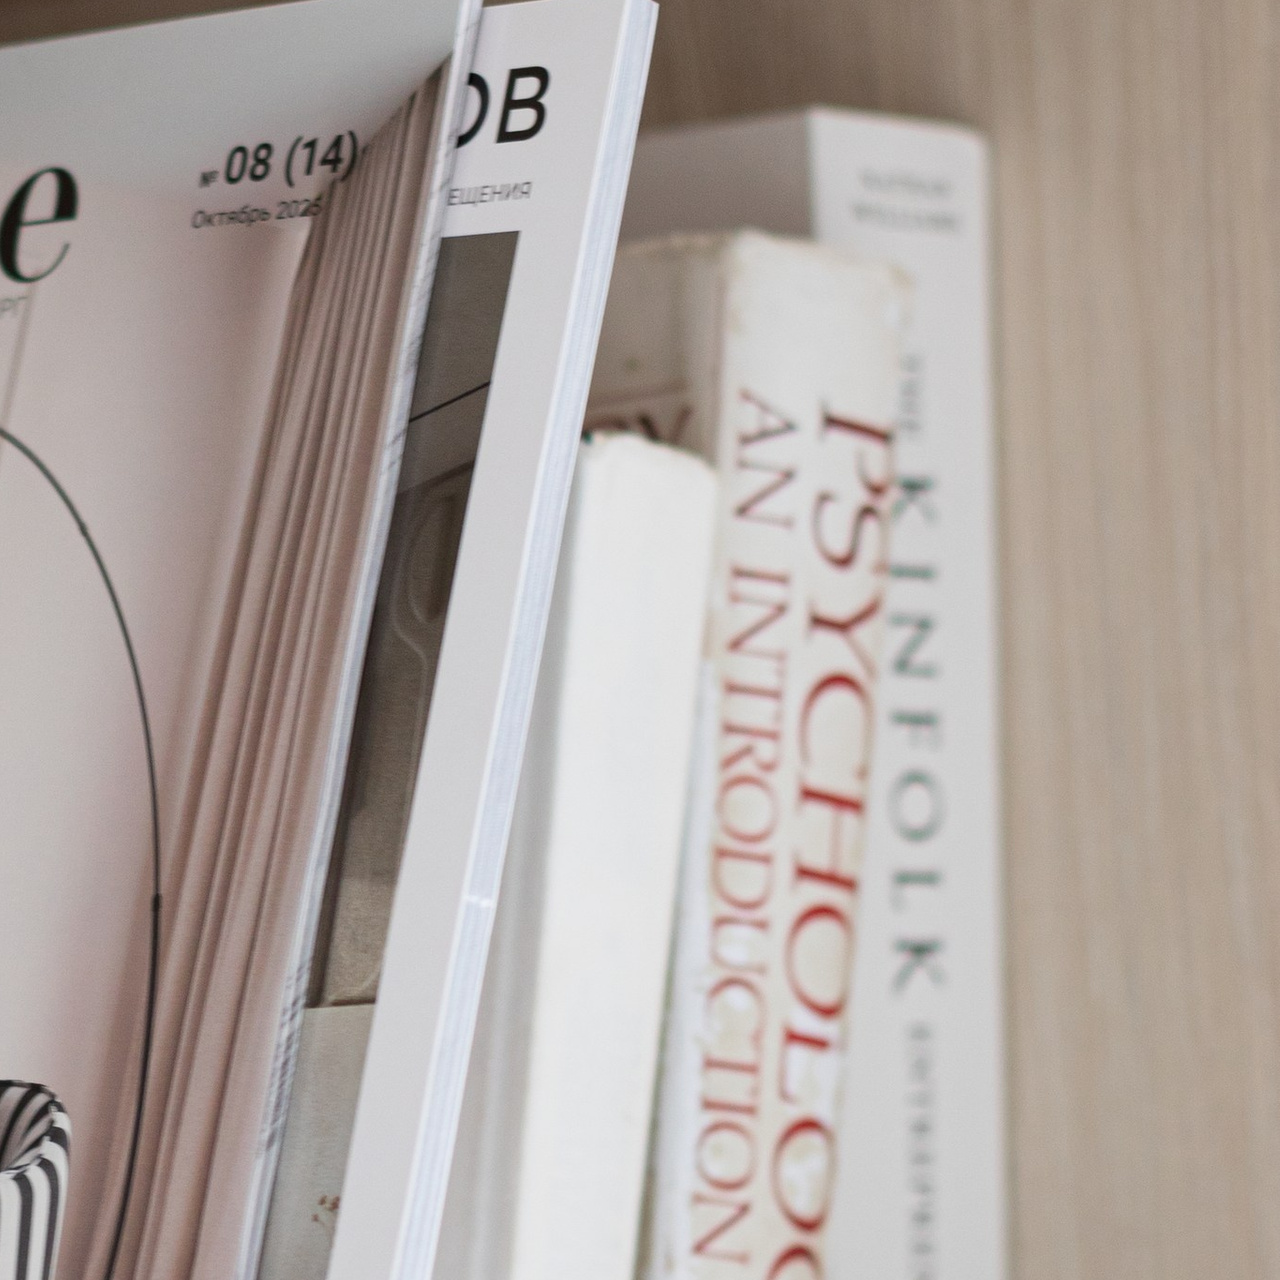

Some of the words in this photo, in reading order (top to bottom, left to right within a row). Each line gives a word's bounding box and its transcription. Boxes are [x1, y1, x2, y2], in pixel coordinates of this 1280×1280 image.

[192, 205, 271, 228] Октябрь
[224, 145, 273, 185] 08
[285, 130, 358, 188] (14)
[733, 388, 797, 529] AN
[888, 474, 944, 994] KINFOLK
[690, 567, 791, 1266] INTRODUCTION
